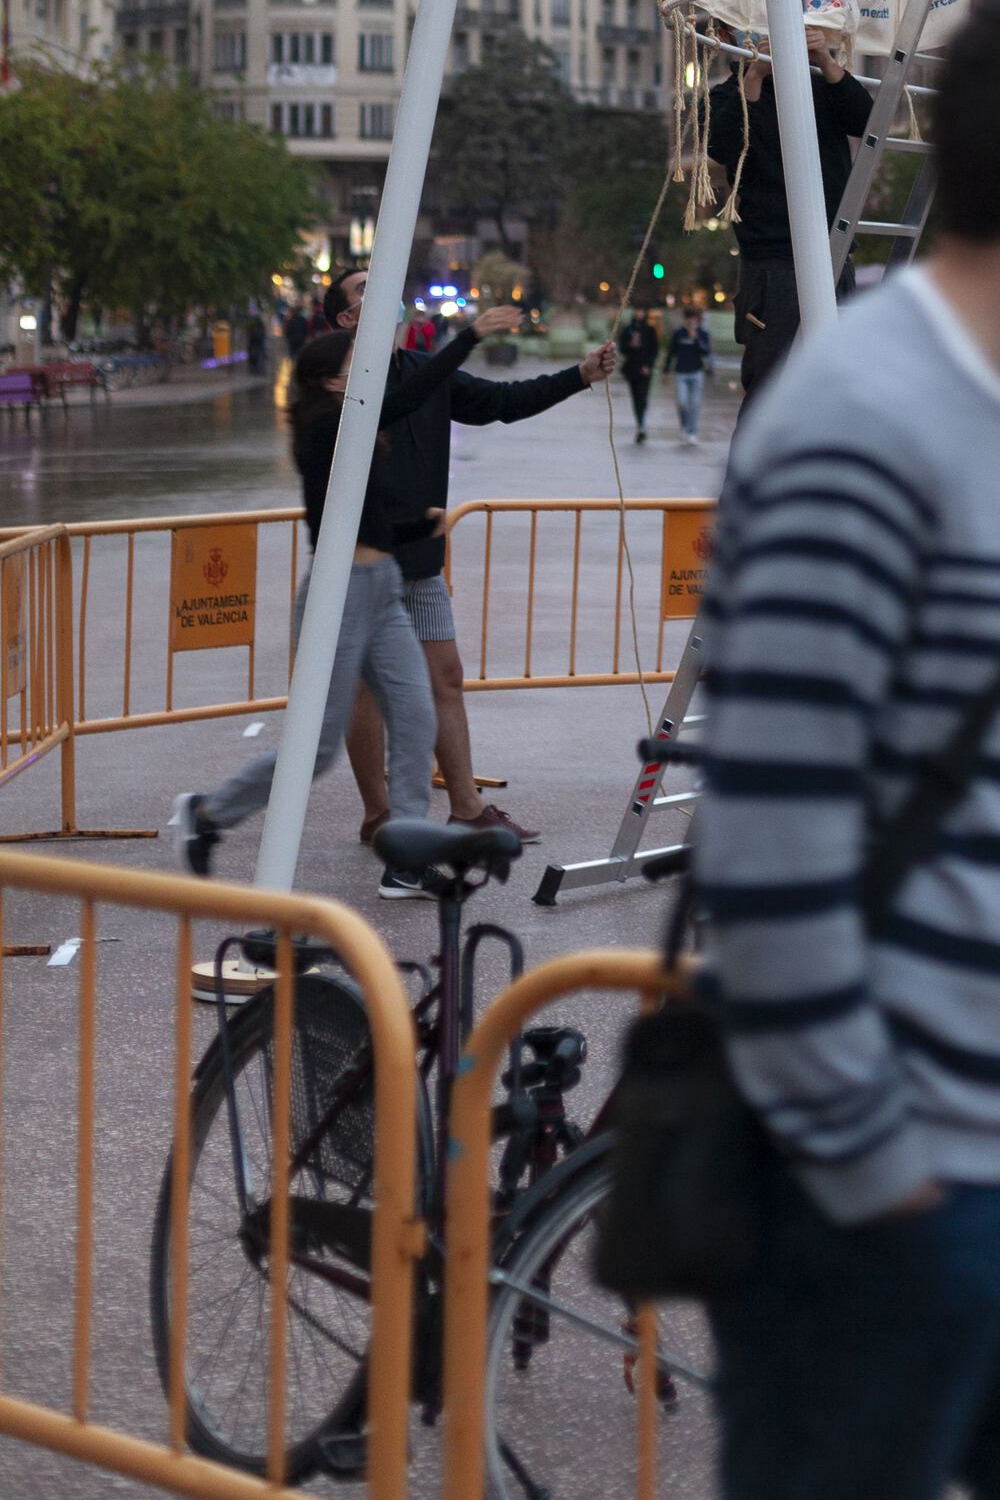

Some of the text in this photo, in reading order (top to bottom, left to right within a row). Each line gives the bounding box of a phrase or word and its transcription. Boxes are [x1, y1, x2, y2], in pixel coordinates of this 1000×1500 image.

[669, 584, 704, 595] DE VAL
[181, 594, 249, 612] AJUNTAMENT
[180, 615, 195, 628] DE
